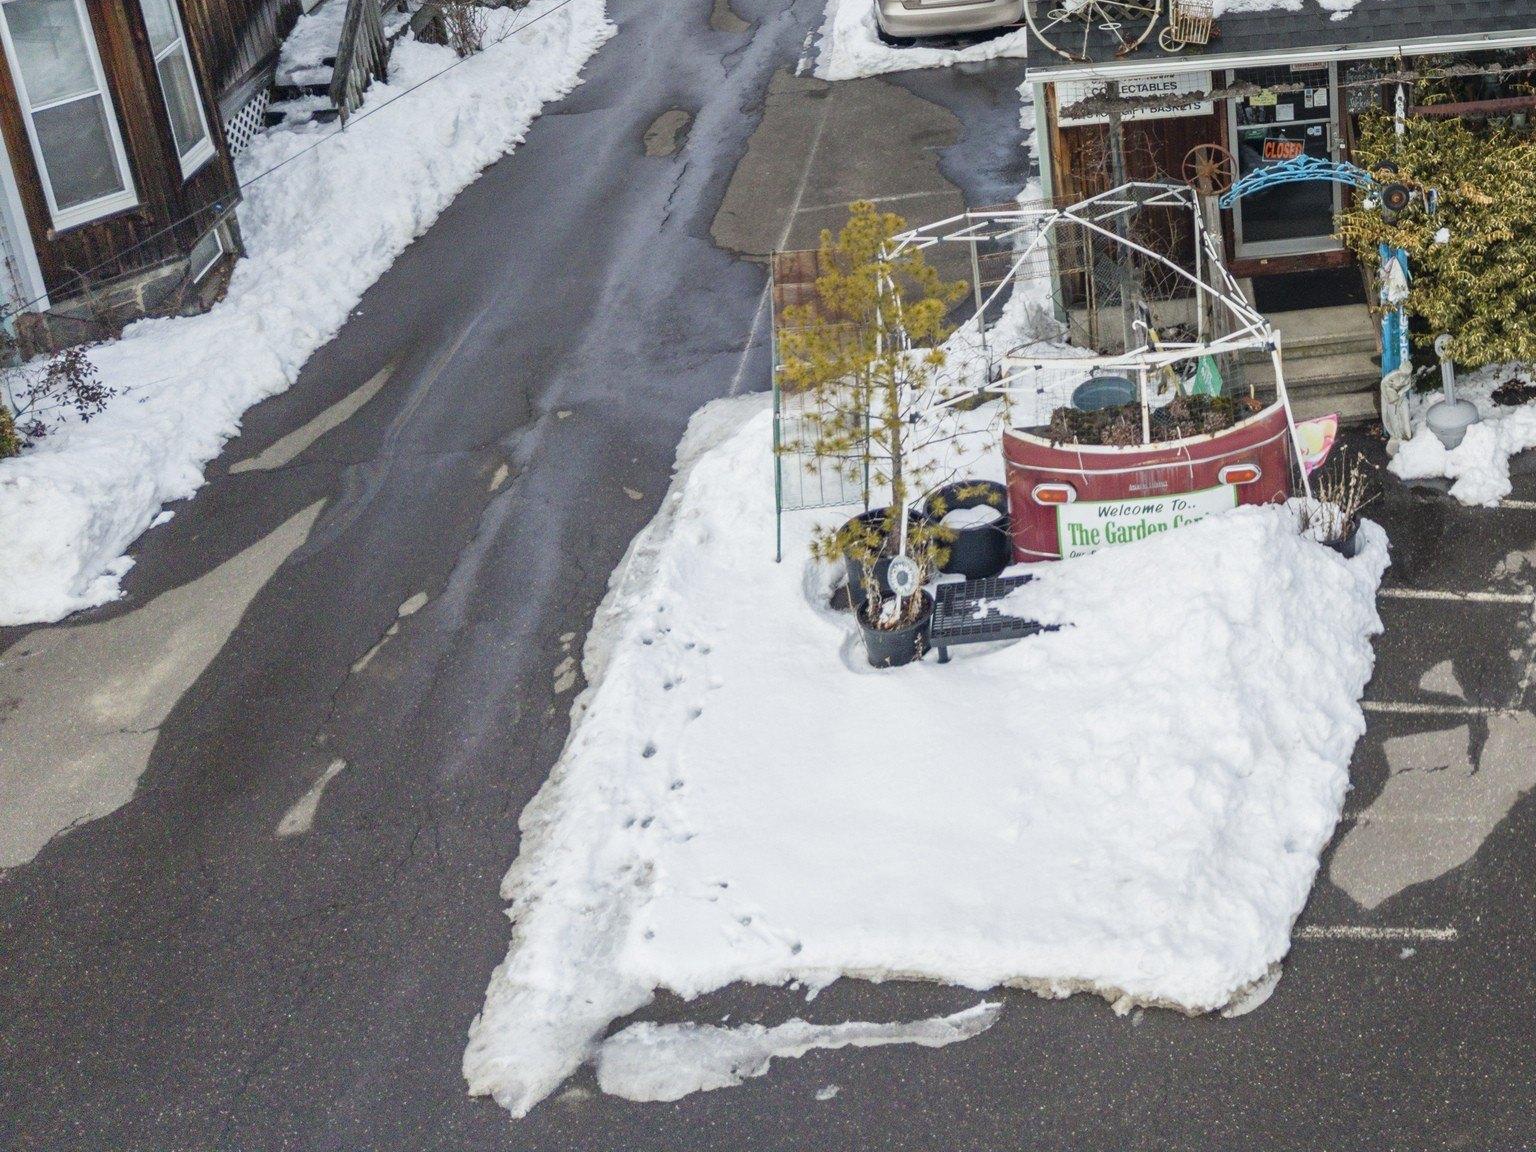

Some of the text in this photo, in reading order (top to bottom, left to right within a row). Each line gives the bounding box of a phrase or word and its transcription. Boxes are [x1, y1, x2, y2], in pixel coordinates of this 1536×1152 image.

[1092, 81, 1178, 97] COECTABLES
[1099, 504, 1163, 517] Welcome
[1068, 523, 1100, 545] The
